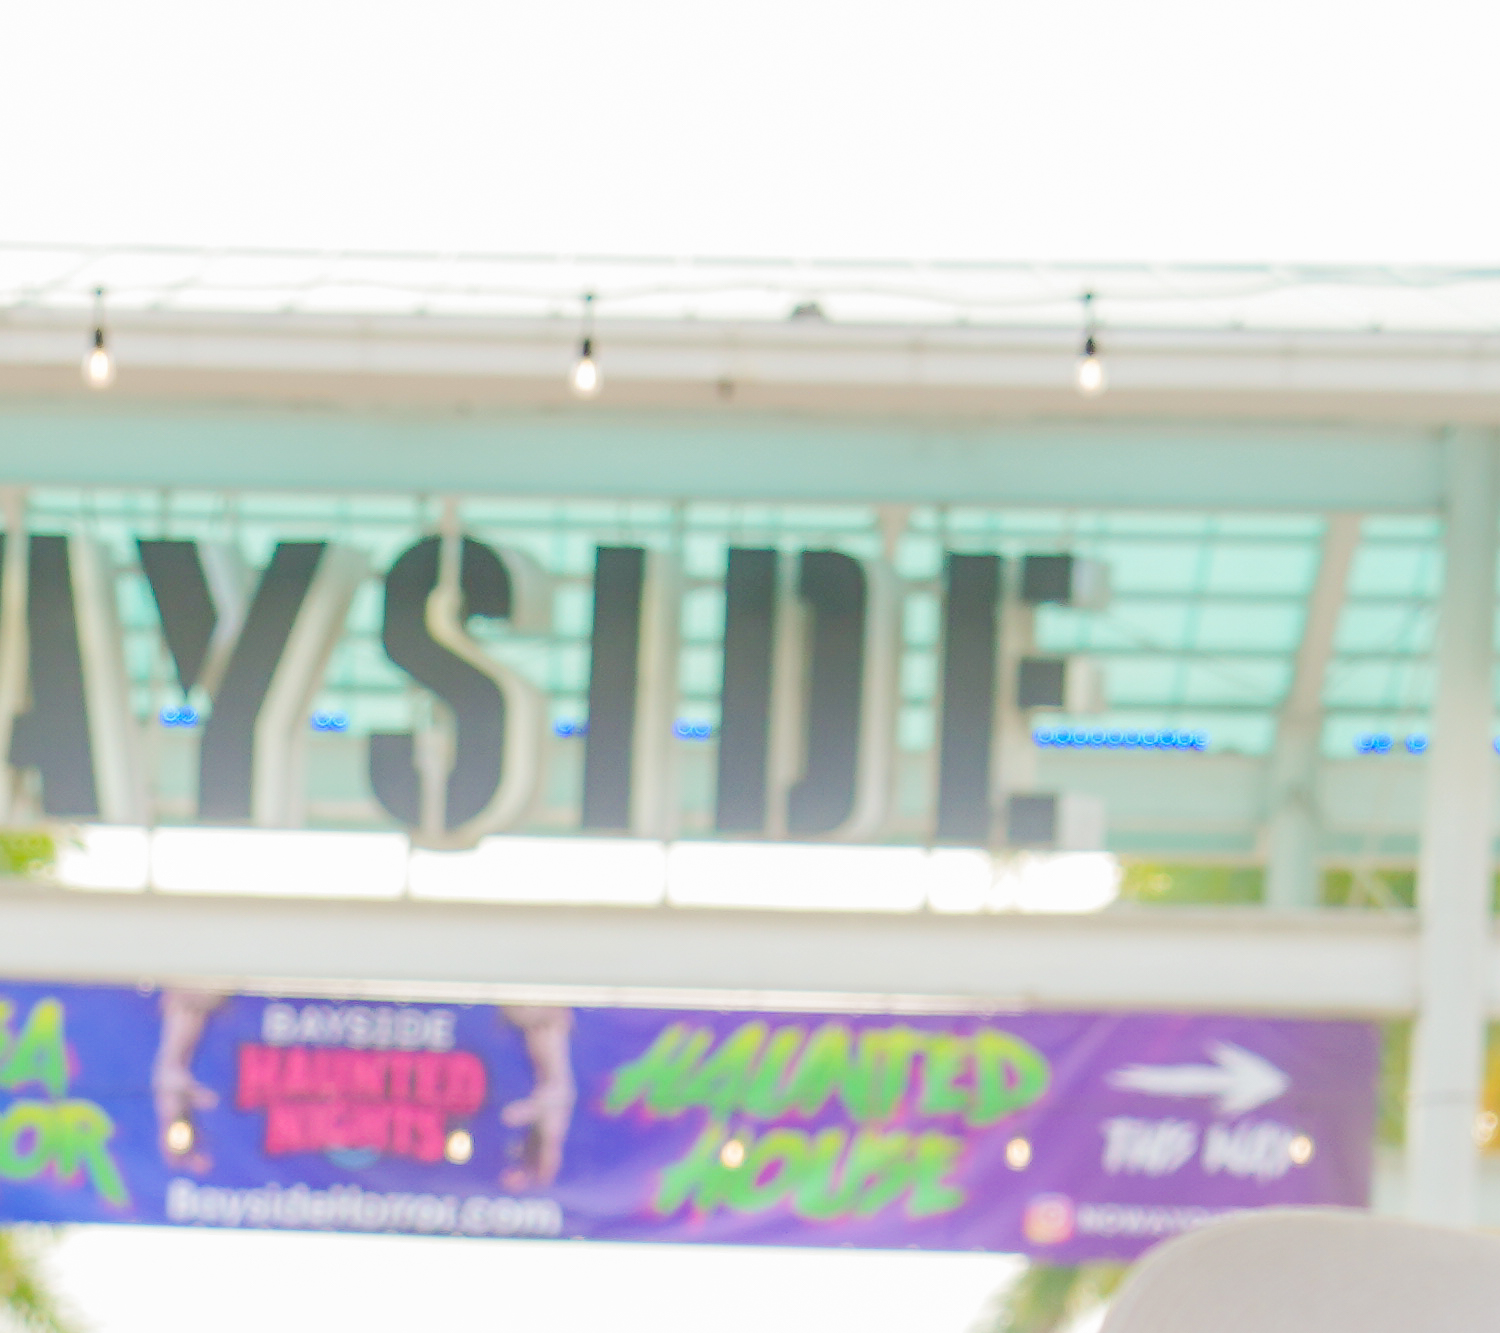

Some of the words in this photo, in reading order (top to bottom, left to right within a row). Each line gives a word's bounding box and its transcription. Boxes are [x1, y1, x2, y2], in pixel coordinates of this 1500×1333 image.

[262, 1003, 457, 1051] BAYSIDE
[237, 1043, 487, 1116] HAUNTED
[604, 1018, 1051, 1127] HAUNTED
[652, 1122, 967, 1220] HOUSE
